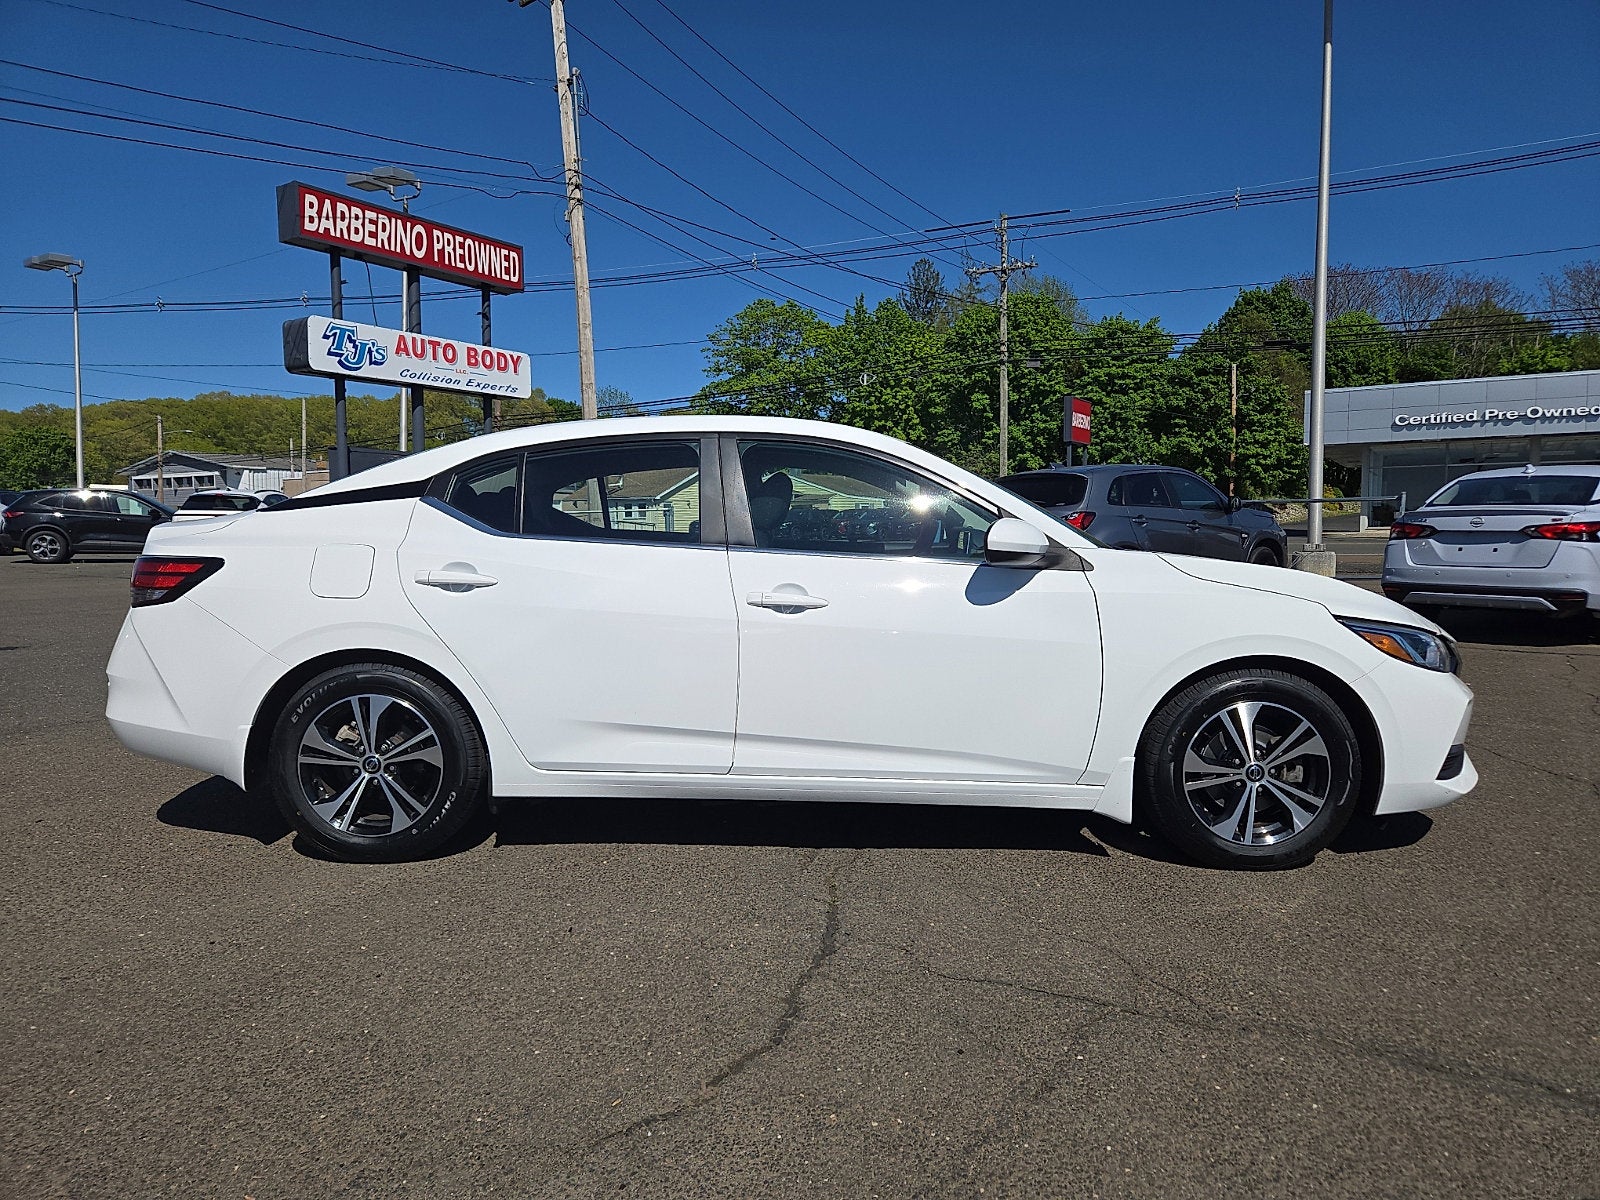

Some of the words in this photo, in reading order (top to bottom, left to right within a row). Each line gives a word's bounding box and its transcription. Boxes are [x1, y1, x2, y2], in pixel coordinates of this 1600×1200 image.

[304, 193, 427, 259] BARBERINO
[433, 229, 520, 283] PREOWNED
[322, 322, 388, 371] TJ's
[395, 334, 458, 365] AUTO
[466, 346, 522, 375] BODY
[399, 368, 461, 386] Collision
[465, 378, 519, 394] Experts
[1394, 409, 1478, 426] Certified
